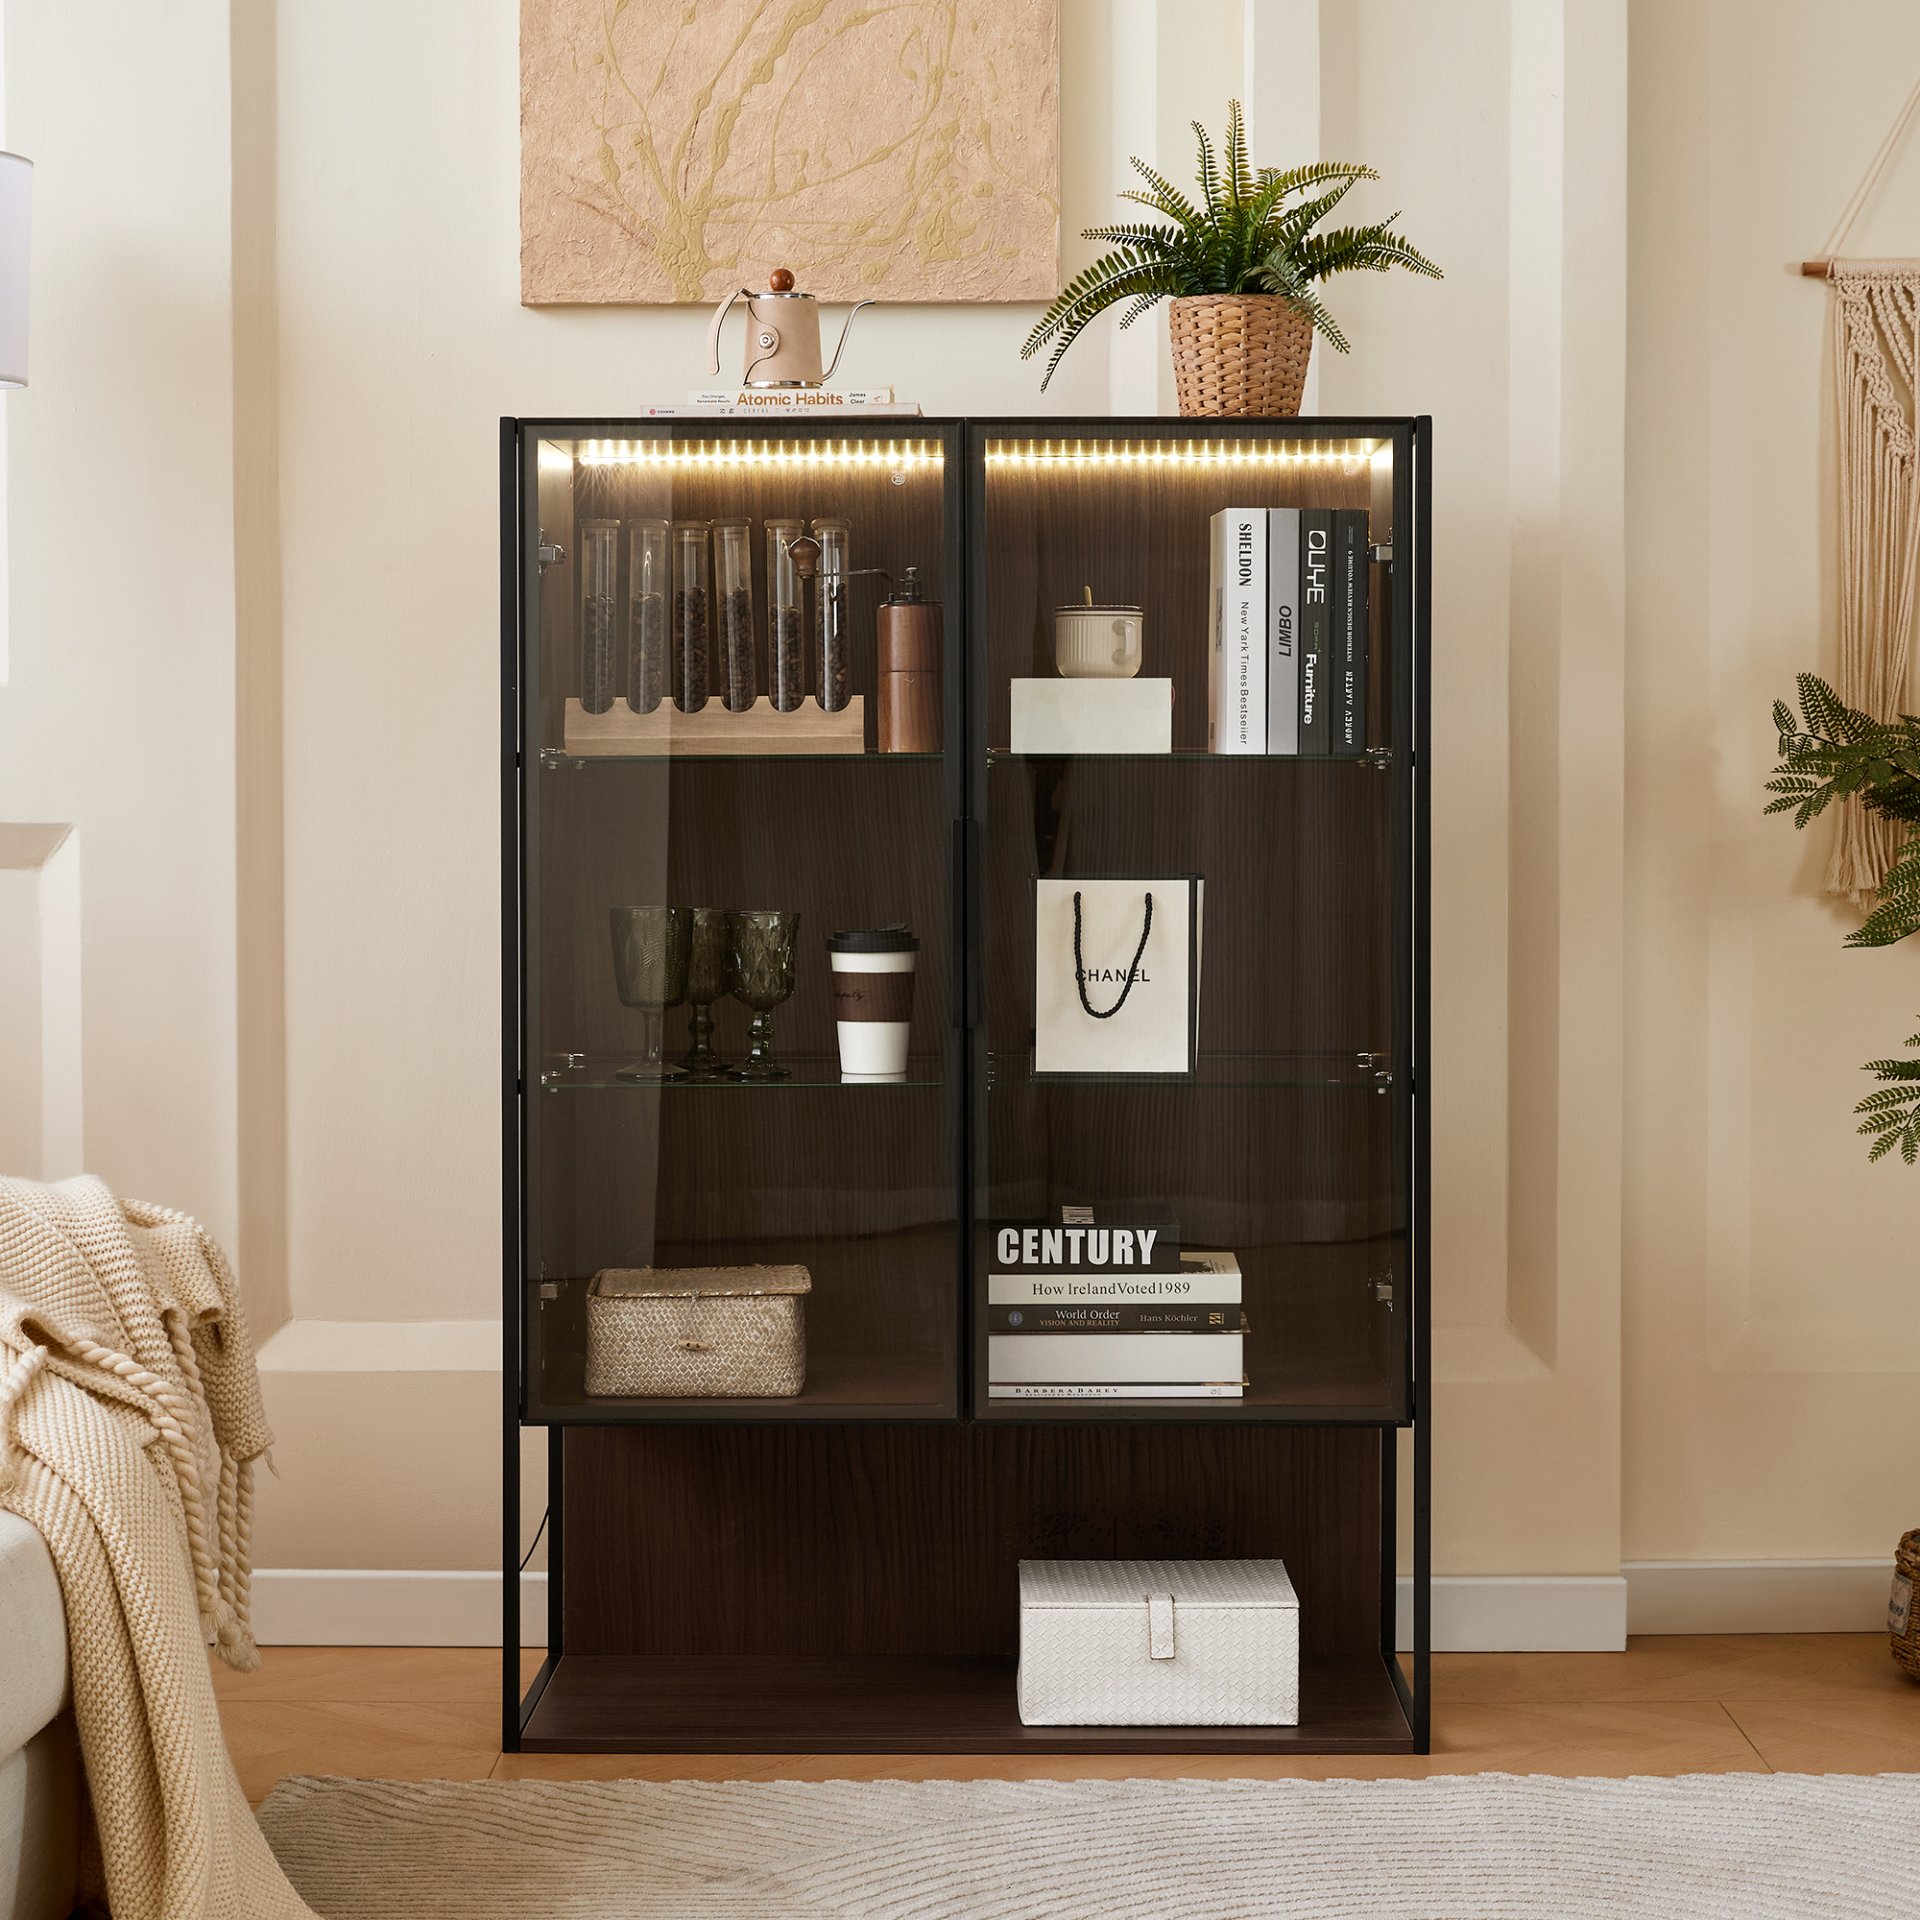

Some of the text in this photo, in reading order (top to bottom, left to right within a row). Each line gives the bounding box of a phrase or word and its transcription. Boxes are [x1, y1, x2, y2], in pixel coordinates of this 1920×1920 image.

[737, 392, 843, 406] Atomic Habits
[1238, 523, 1252, 587] SHELDON
[1240, 601, 1249, 625] New
[1279, 605, 1292, 657] LIMBO
[1240, 654, 1249, 687] Times
[1304, 653, 1317, 725] Furniture
[1075, 968, 1151, 982] CHANEL
[997, 1228, 1158, 1265] CENTURY
[1032, 1283, 1064, 1295] How
[1040, 1319, 1120, 1327] VISION AND REALITY
[1055, 1310, 1120, 1320] World Order
[1140, 1313, 1198, 1322] Hans Köchler
